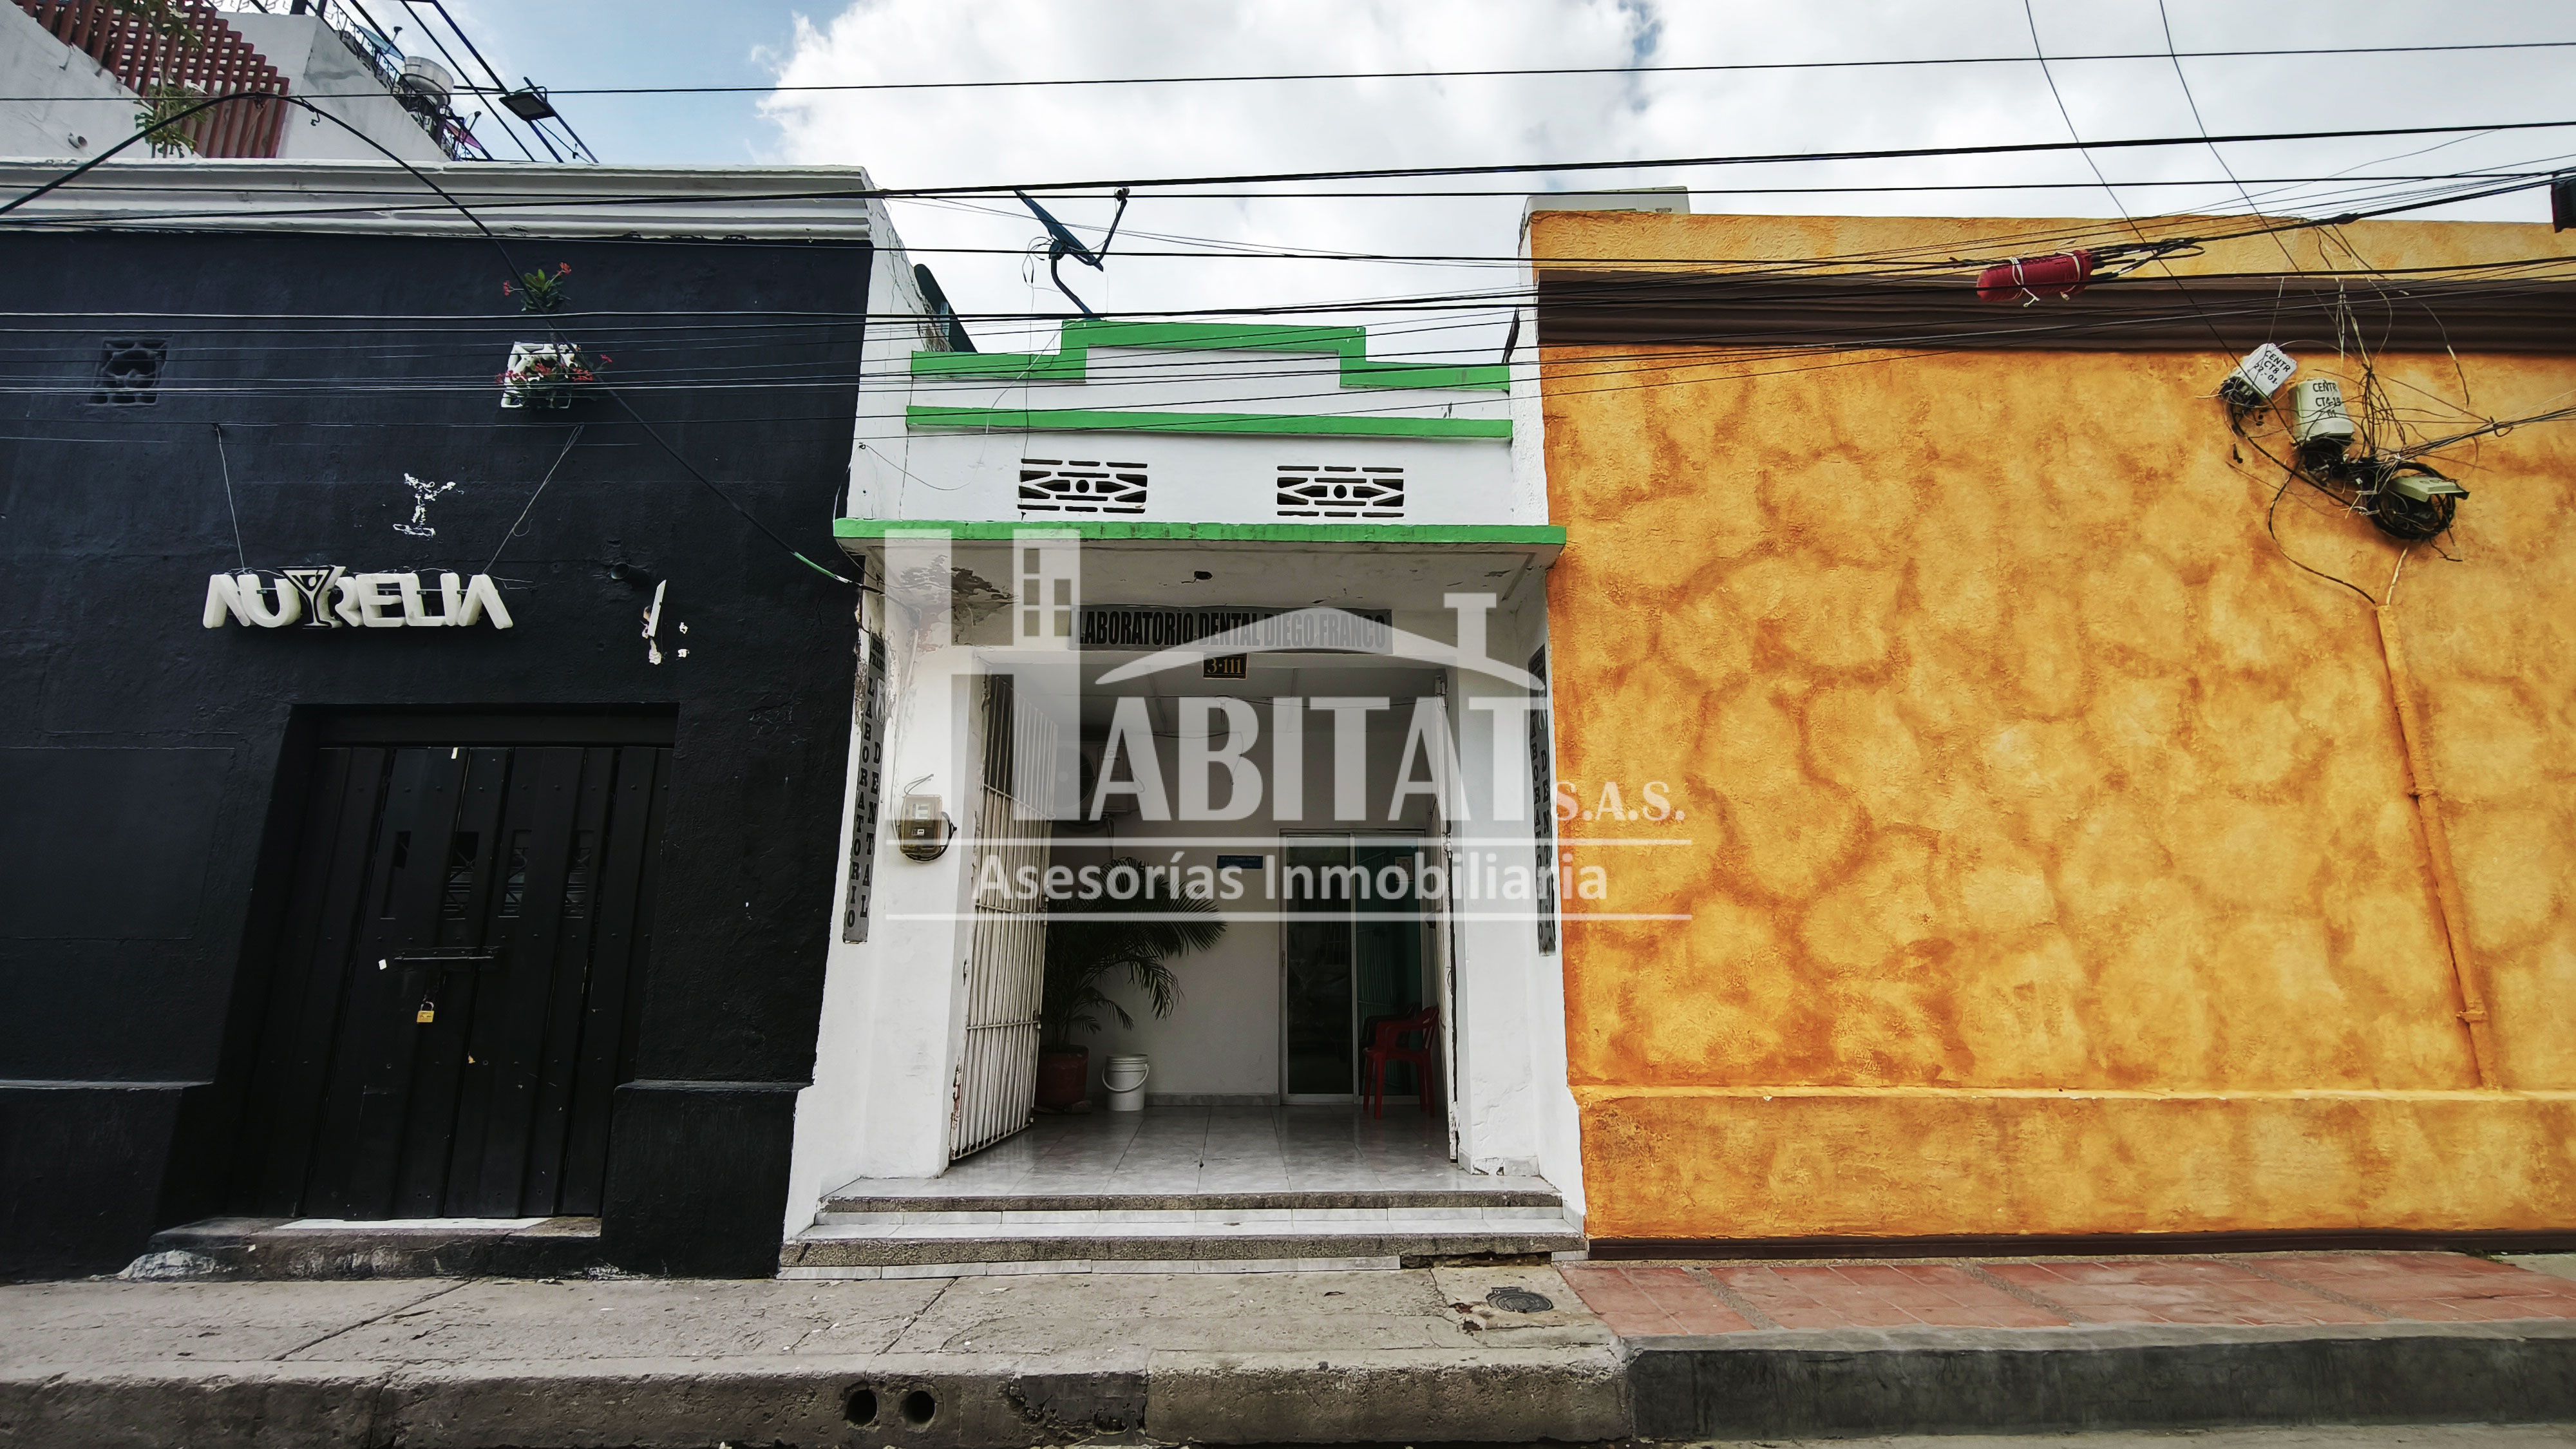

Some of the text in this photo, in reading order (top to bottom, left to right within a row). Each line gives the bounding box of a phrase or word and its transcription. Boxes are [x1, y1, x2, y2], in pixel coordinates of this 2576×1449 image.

[2264, 350, 2291, 372] CENTR
[1076, 611, 1385, 649] LABORATORIO DENTAL DIEGO FRANCO
[847, 676, 875, 929] LABORATORIO
[859, 743, 882, 918] DENTAL
